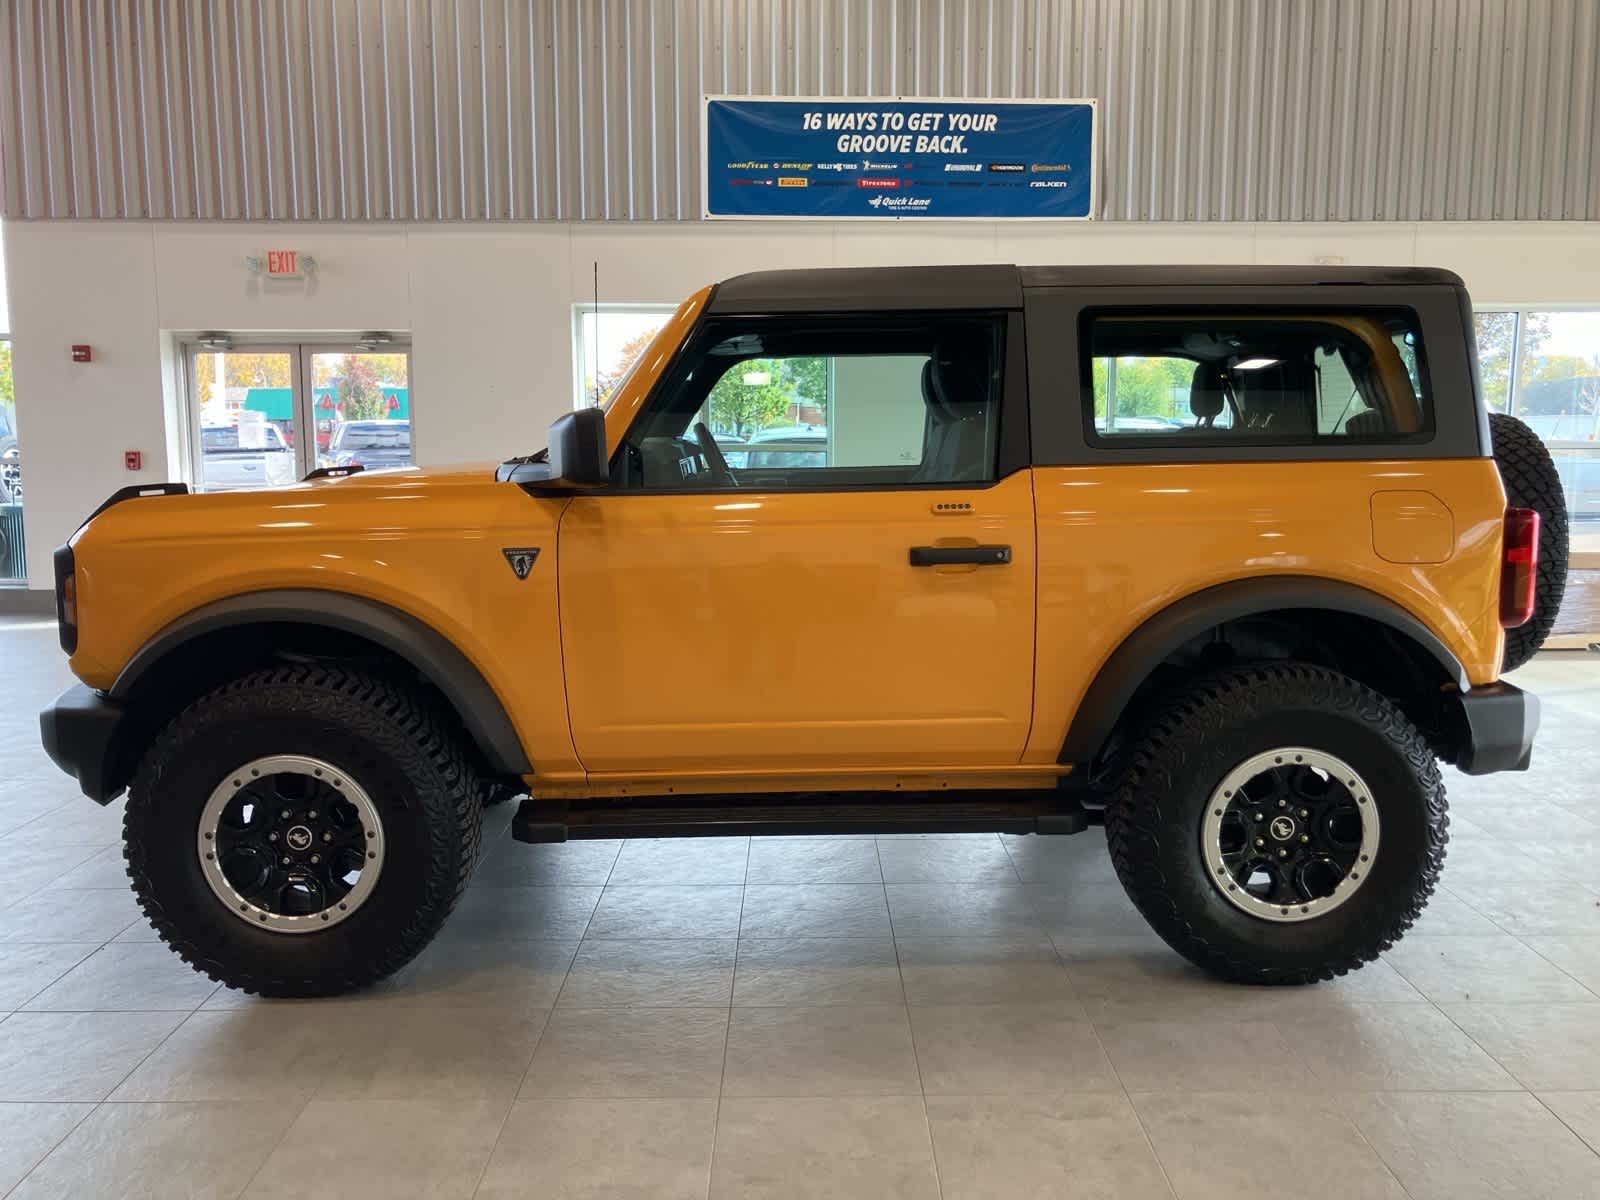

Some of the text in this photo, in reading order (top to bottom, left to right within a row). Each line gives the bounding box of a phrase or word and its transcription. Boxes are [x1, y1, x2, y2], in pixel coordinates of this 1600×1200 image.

[803, 112, 998, 132] 16 WAYS TO GET YOUR
[837, 135, 968, 154] GROOVE BACK.
[882, 197, 931, 206] Quick Lane
[268, 250, 296, 273] EXIT
